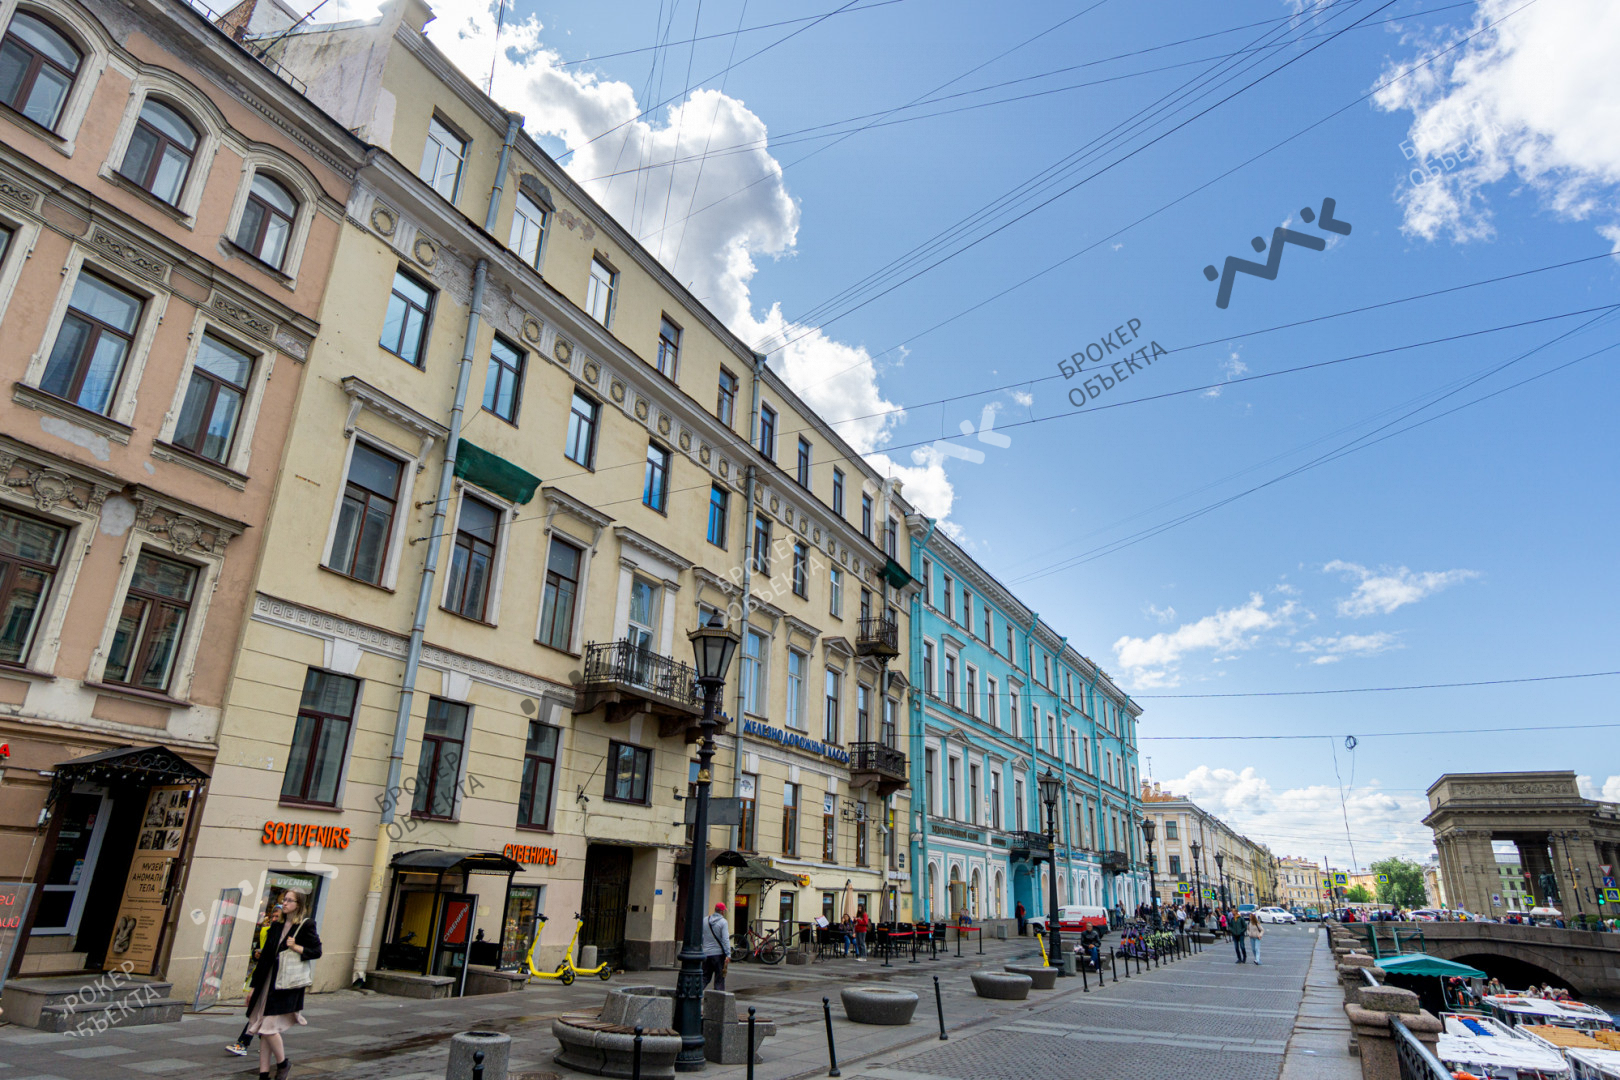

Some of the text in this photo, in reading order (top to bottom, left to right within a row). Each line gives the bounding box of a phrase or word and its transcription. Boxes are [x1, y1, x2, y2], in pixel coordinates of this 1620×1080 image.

[743, 719, 850, 764] ЖЕЛЕЗНОДОРОЖНЫЕ КАССЫ
[262, 821, 351, 849] SOUVENIRS
[503, 842, 558, 865] СУВЕНИРЫ
[142, 862, 164, 871] МУЗЕЙ
[139, 884, 155, 892] ТЕЛА
[443, 903, 469, 942] СУВЕНИРЫ
